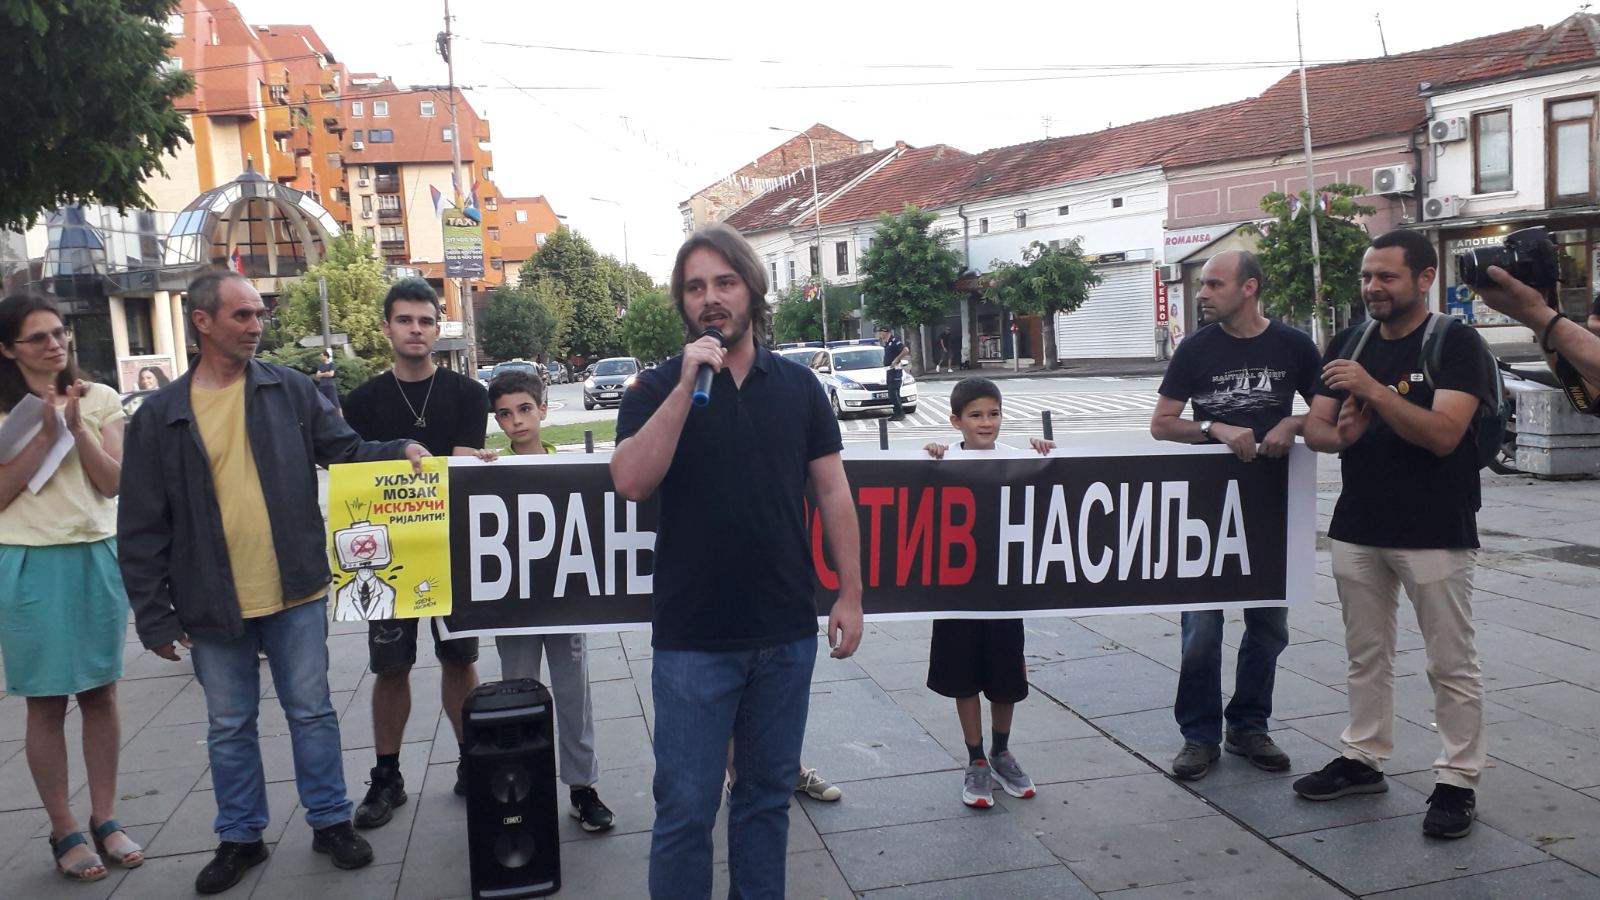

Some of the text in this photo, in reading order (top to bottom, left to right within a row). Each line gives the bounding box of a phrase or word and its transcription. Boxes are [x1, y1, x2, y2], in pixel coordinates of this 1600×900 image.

[1165, 233, 1211, 246] ROMANSA
[1457, 236, 1503, 248] АПОТЕК
[375, 472, 440, 487] УКЉУЧИ
[383, 486, 437, 500] МОЗАК
[373, 500, 445, 514] ИСКЉУЧИ
[389, 513, 446, 525] РИЈАЛИТИ!
[468, 491, 657, 601] ВРАЊ
[997, 479, 1251, 586] НАСИЉА
